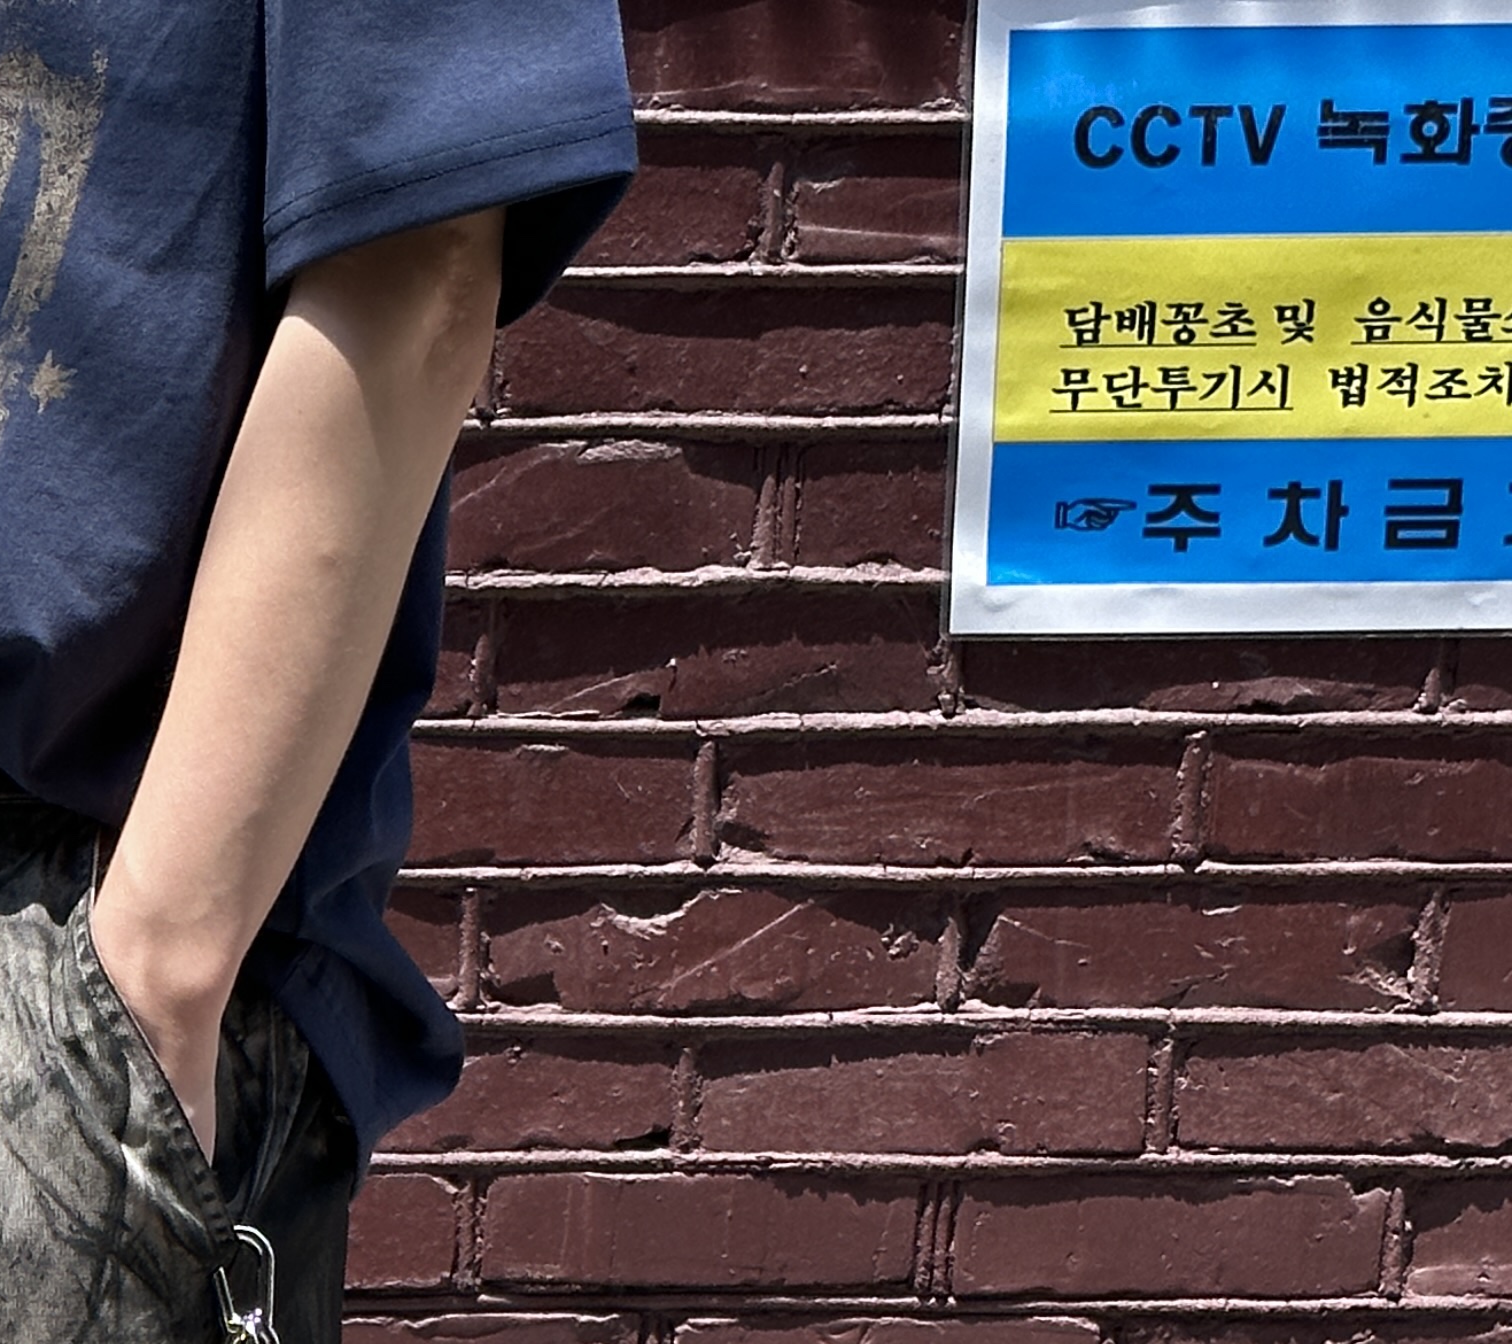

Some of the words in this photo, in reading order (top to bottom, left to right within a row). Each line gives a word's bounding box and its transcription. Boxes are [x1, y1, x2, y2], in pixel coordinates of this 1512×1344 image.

[1073, 103, 1287, 169] CCTV
[1064, 301, 1257, 347] 담배꽁초
[1273, 298, 1316, 345] 및
[1051, 364, 1291, 412] 무단투기시
[1328, 361, 1512, 408] 법적조치
